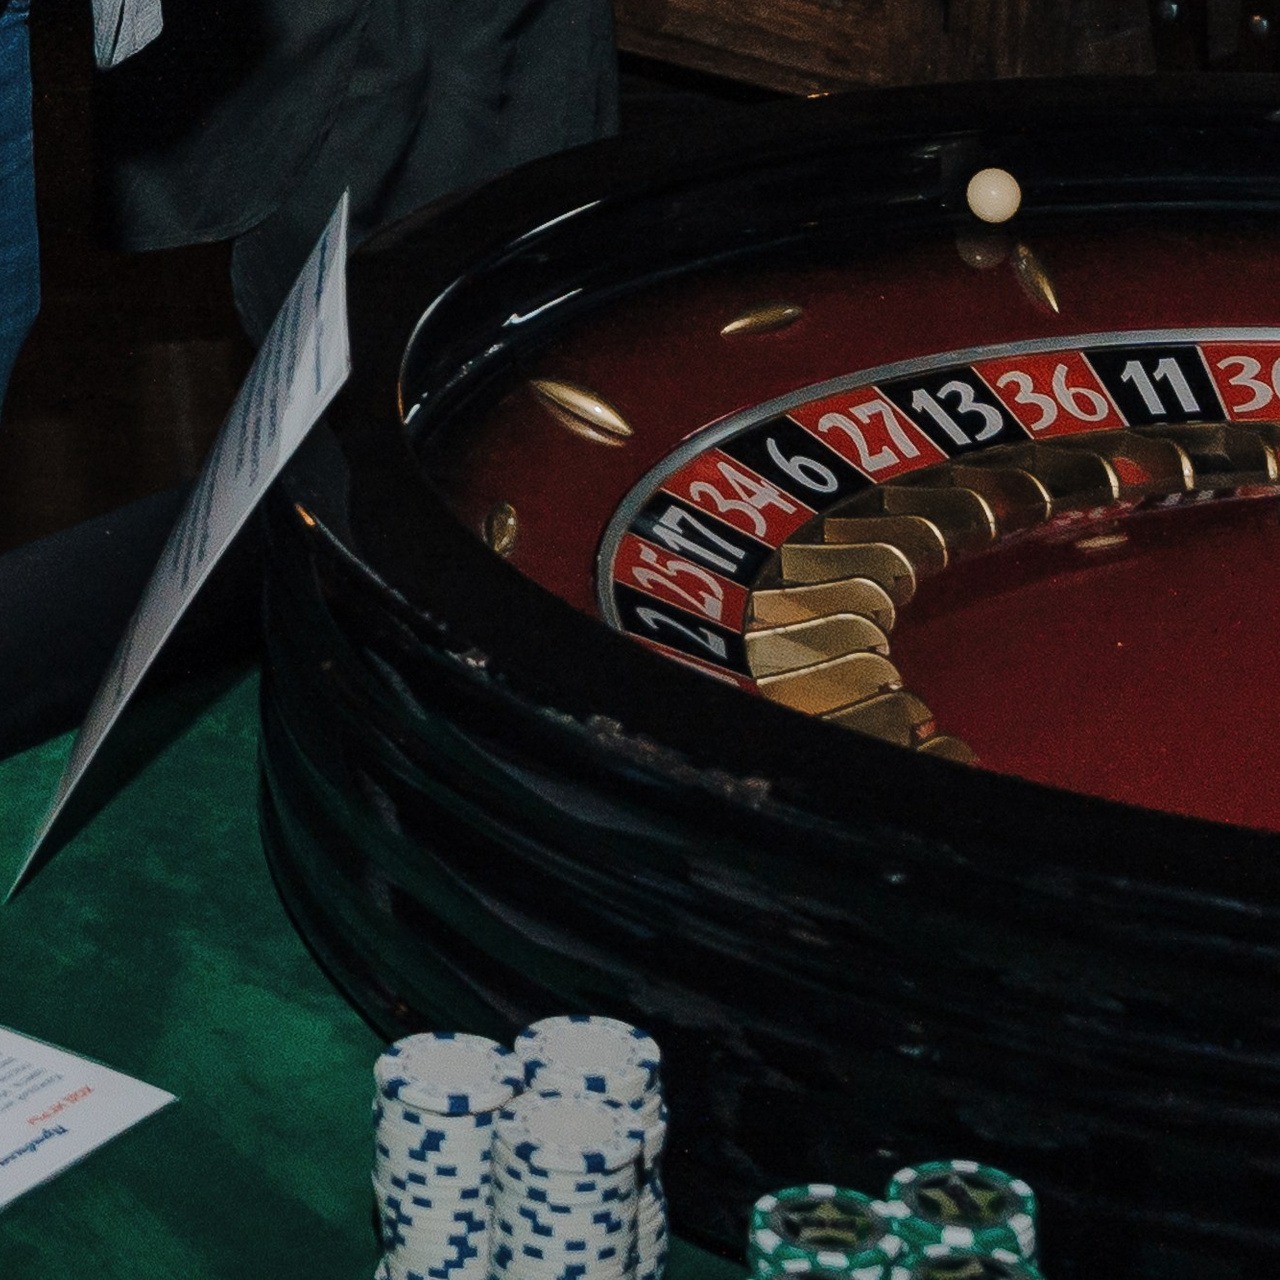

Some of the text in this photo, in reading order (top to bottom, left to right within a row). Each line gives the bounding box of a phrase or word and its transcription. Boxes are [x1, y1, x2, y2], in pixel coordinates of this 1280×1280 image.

[912, 380, 1004, 446] 13
[996, 363, 1109, 431] 36
[1120, 357, 1200, 415] 11
[766, 438, 839, 493] 6
[818, 398, 920, 476] 27
[690, 462, 798, 538] 34
[652, 505, 746, 573] 17
[632, 543, 724, 620] 25
[636, 607, 728, 660] 2
